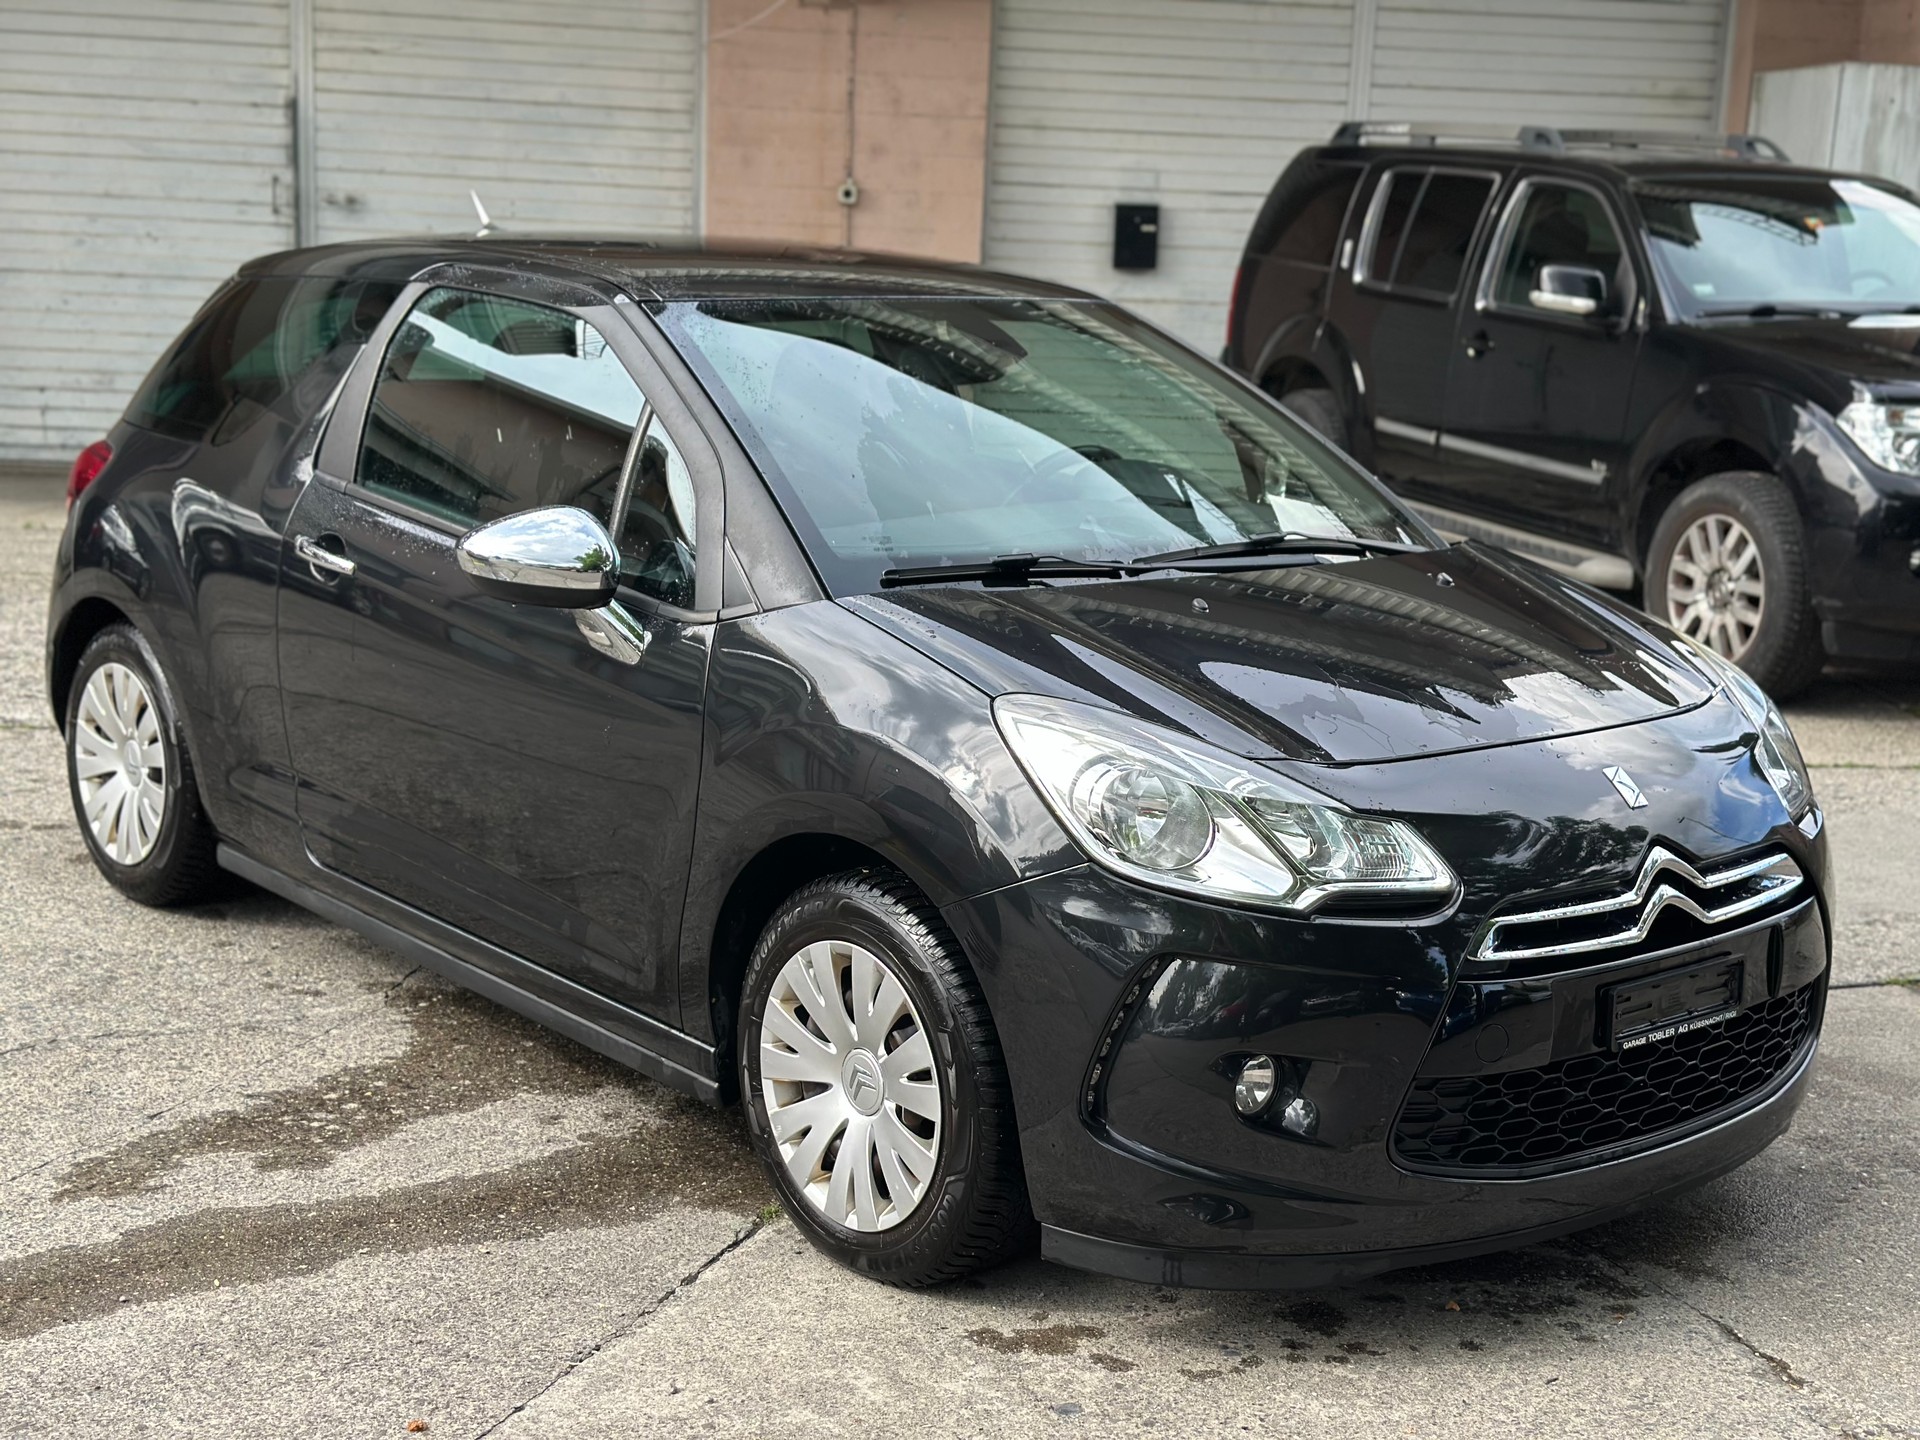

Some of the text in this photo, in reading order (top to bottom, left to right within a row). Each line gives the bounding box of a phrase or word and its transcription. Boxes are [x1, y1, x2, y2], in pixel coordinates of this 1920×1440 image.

[1623, 1036, 1647, 1050] GARAGE
[1648, 1027, 1675, 1042] TOBLER
[1677, 1023, 1689, 1034] AG
